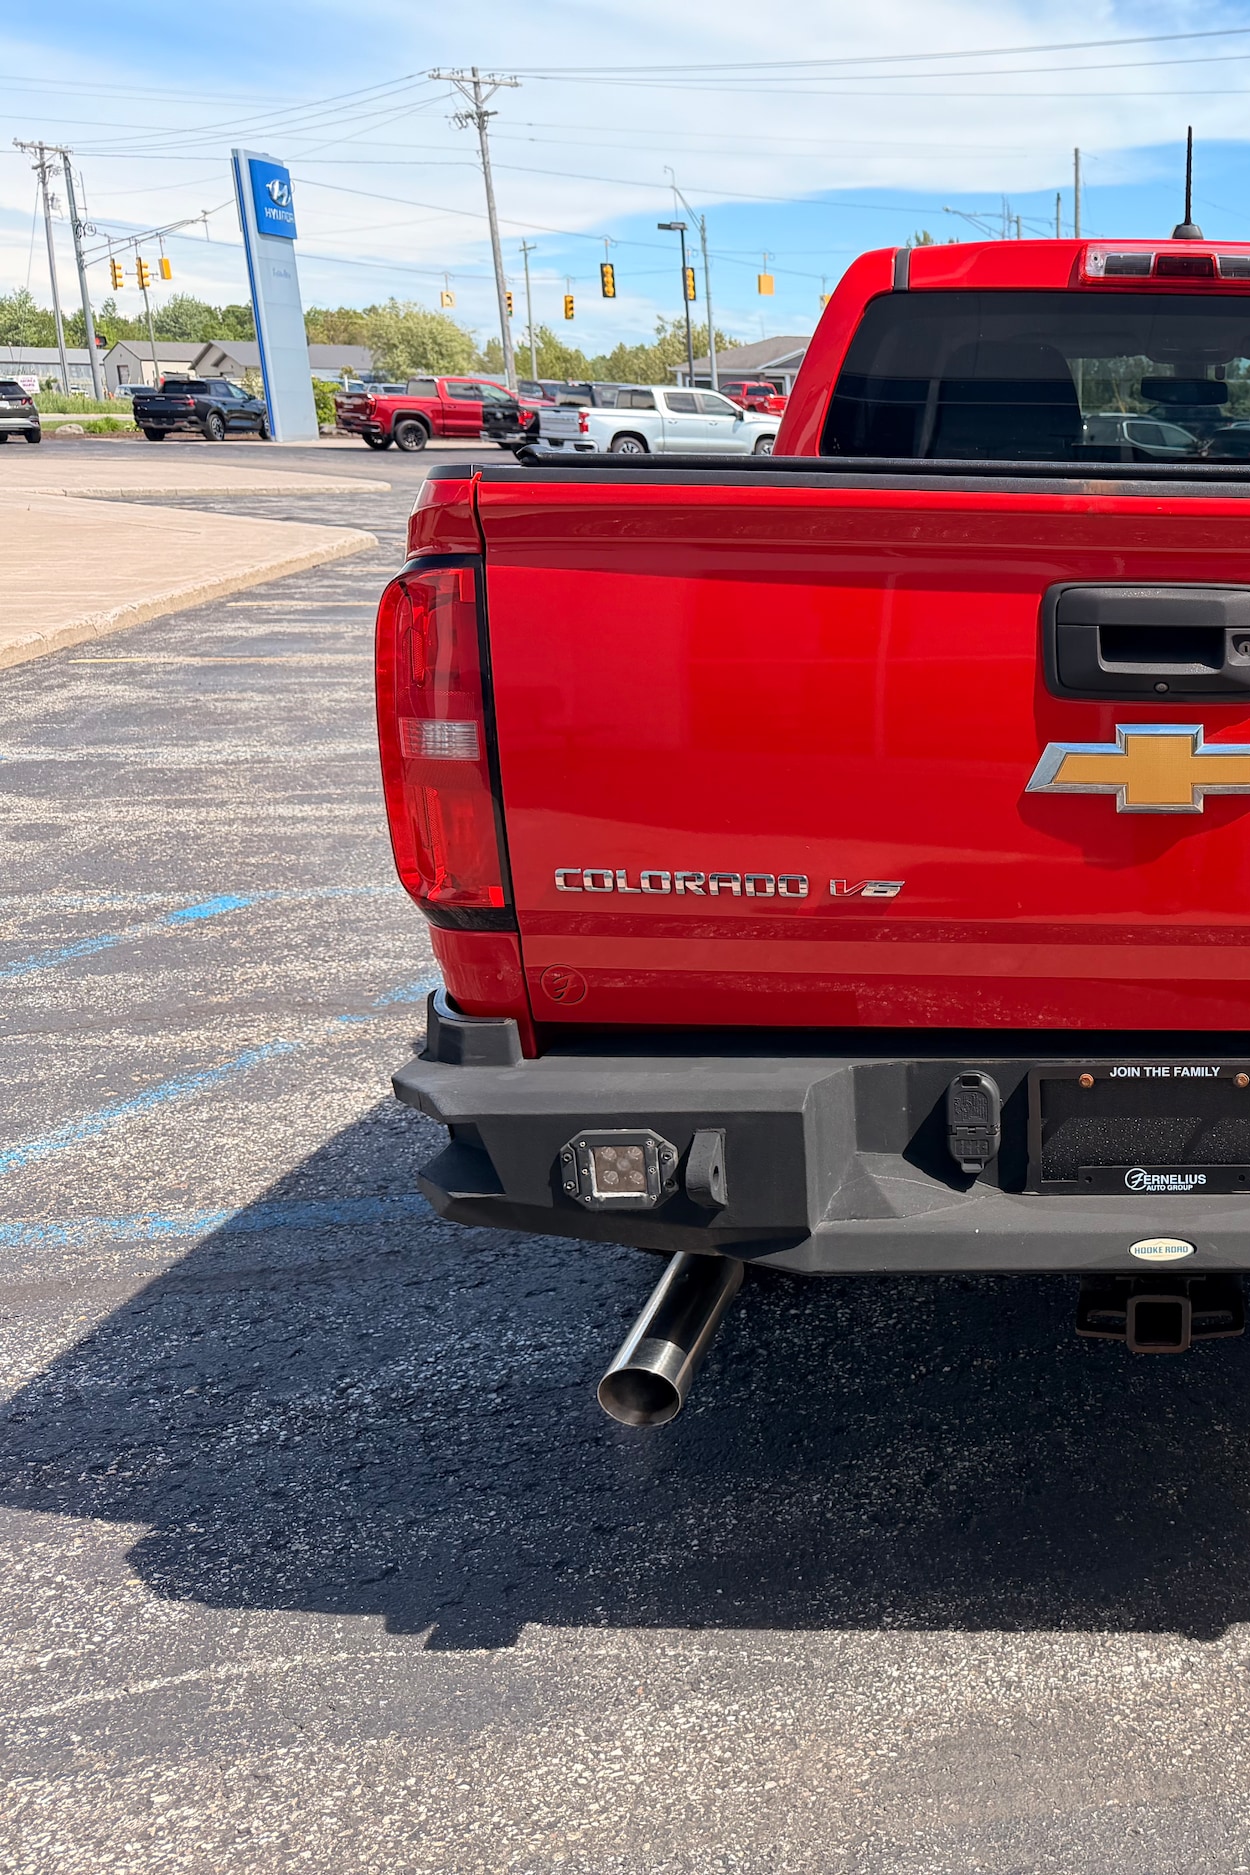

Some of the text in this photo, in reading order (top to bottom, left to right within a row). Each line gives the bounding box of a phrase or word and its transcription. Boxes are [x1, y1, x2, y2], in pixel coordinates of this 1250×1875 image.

[554, 868, 905, 898] COLORADO V6
[1110, 1066, 1221, 1078] JOIN THE FAMILY
[1126, 1169, 1207, 1189] FERNELIUS
[1146, 1184, 1194, 1192] AUTO GROUP
[1134, 1245, 1189, 1255] HOOKE ROAD
